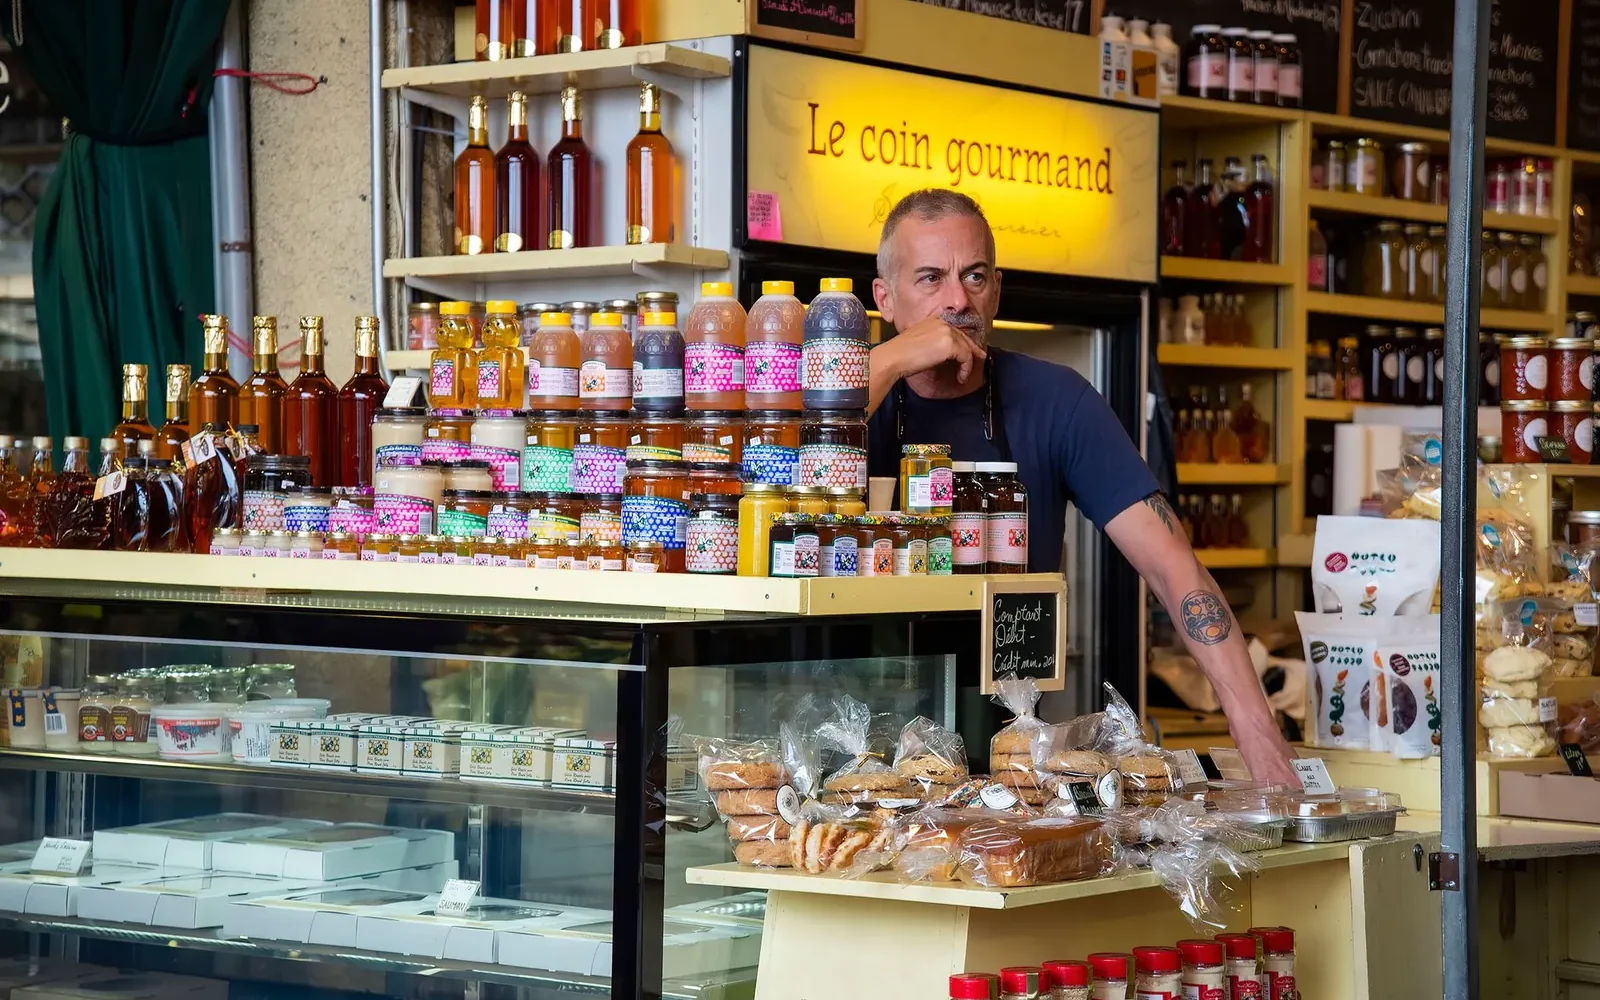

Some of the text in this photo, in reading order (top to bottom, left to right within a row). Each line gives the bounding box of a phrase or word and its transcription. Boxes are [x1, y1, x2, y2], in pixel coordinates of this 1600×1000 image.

[807, 101, 1115, 194] Le coin gourmand
[993, 599, 1043, 628] Comptant
[995, 623, 1026, 648] Débit
[993, 650, 1021, 673] Crédit
